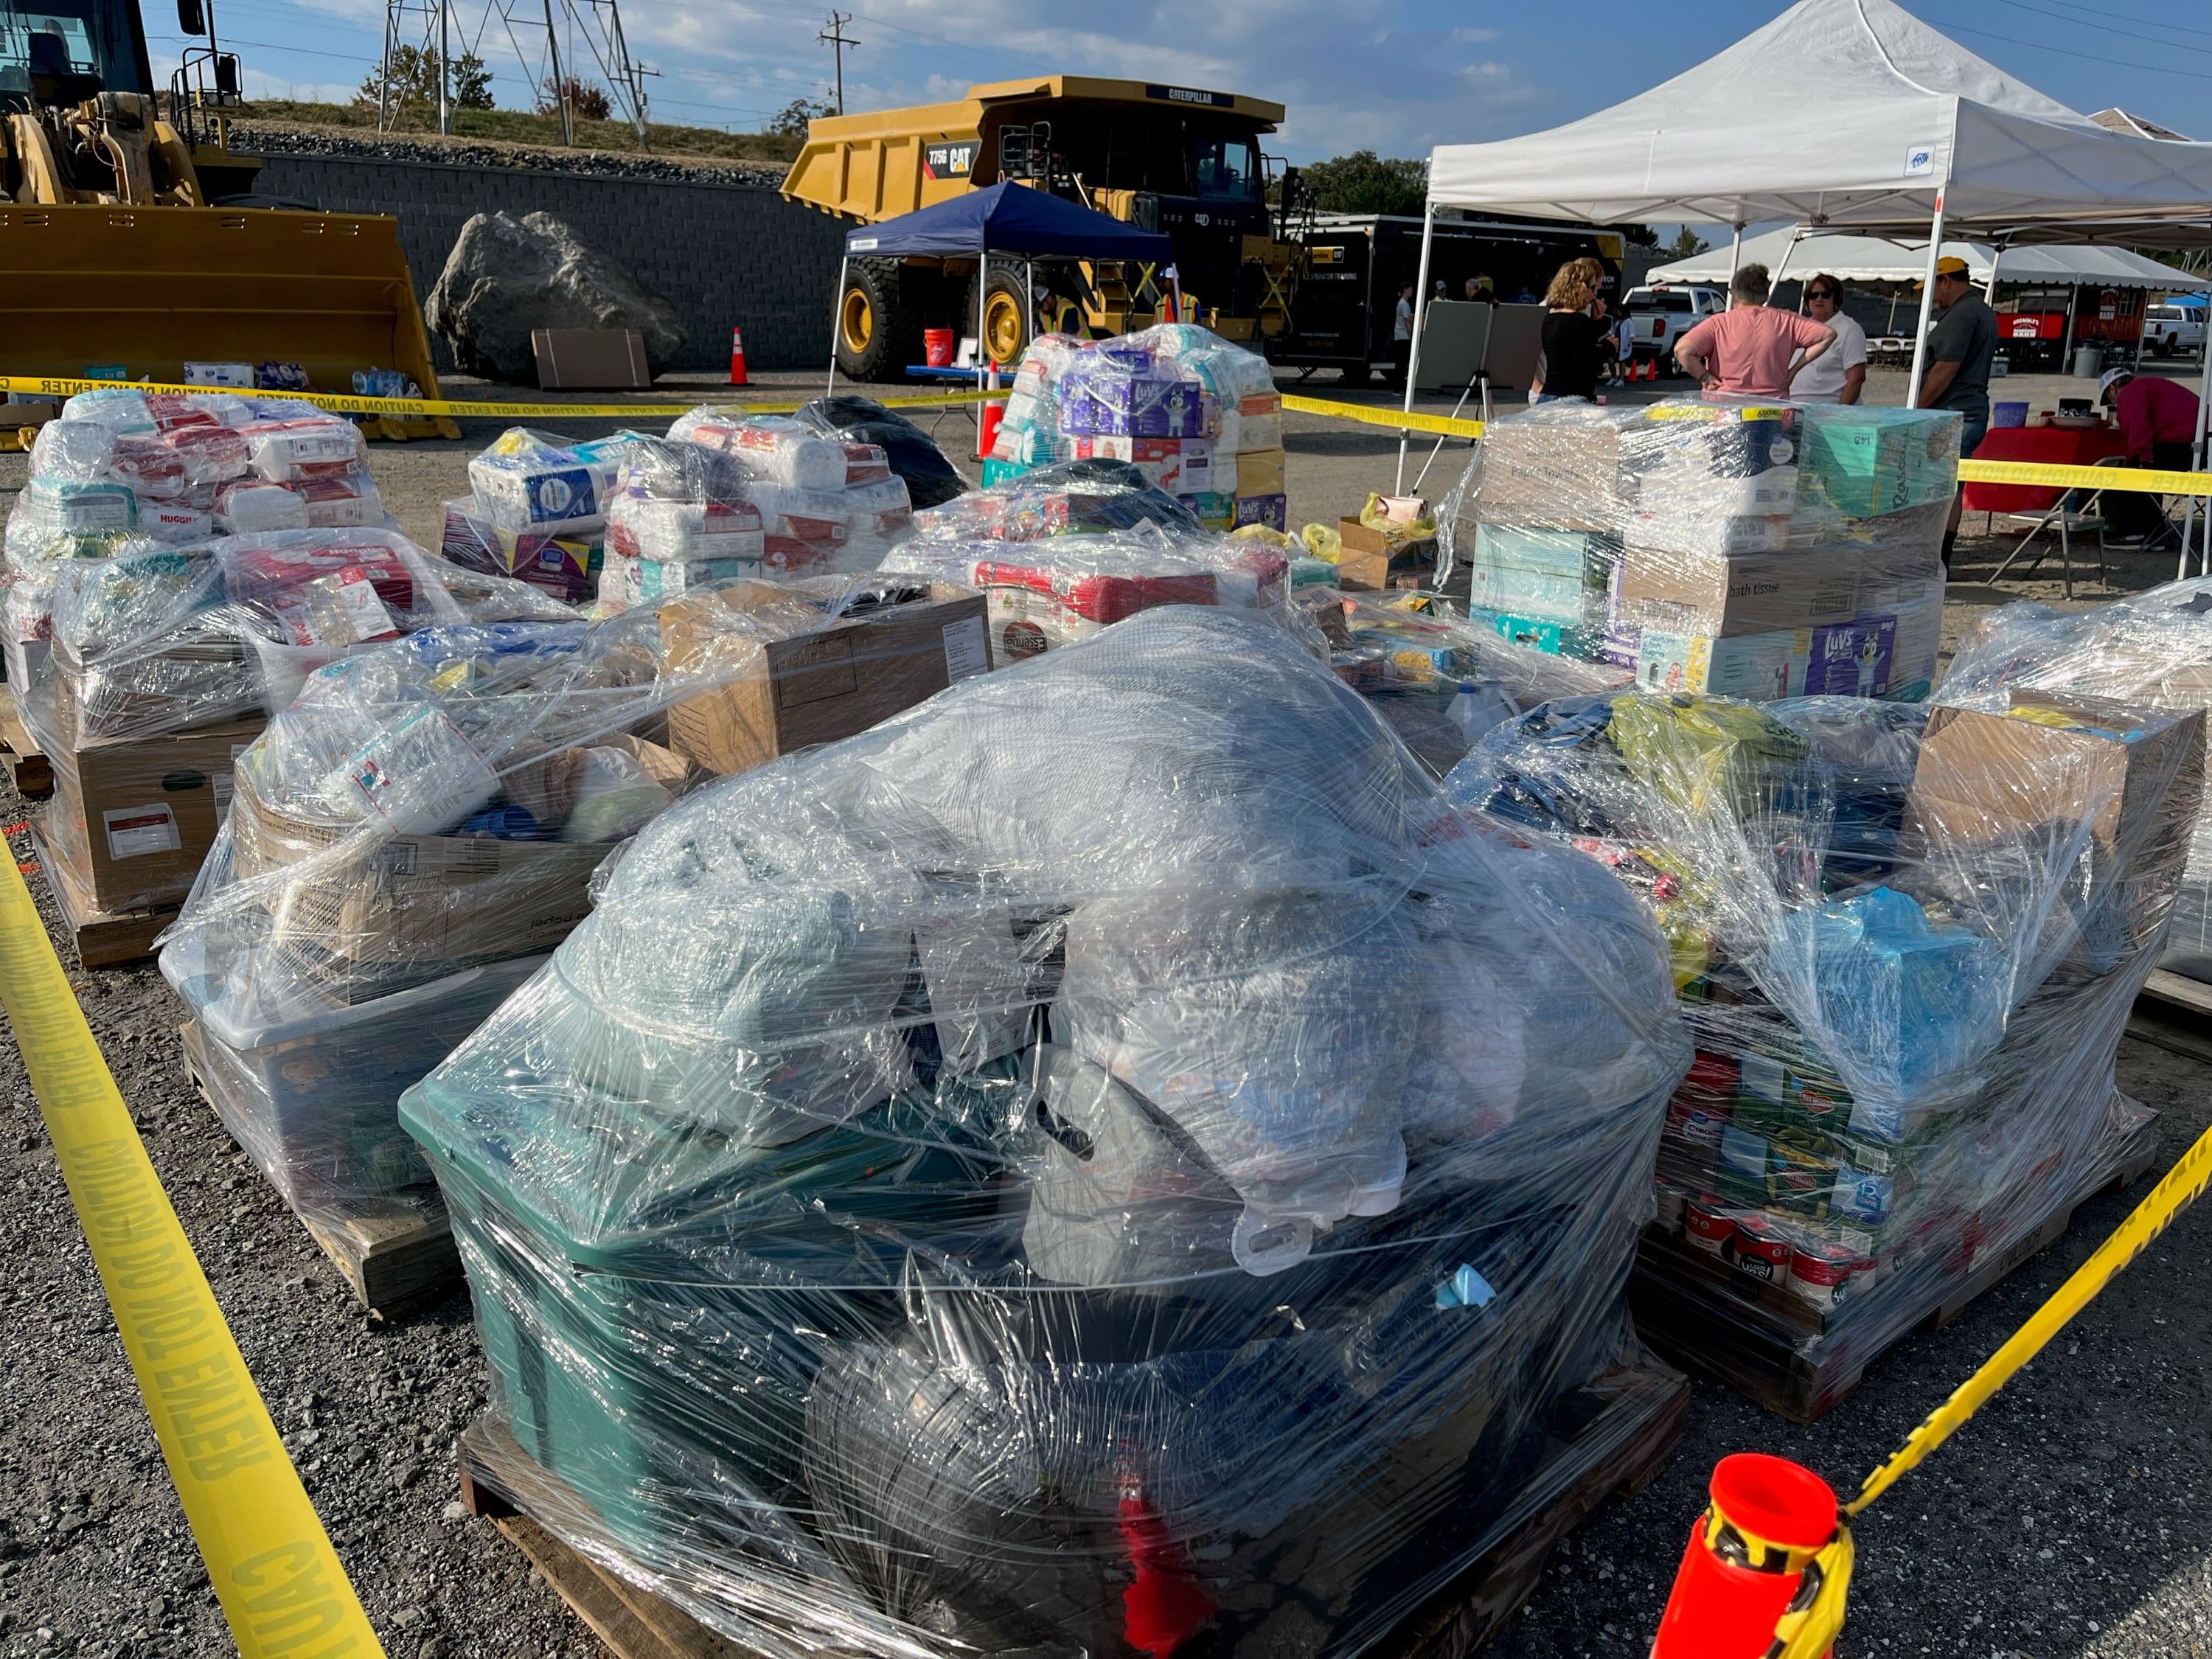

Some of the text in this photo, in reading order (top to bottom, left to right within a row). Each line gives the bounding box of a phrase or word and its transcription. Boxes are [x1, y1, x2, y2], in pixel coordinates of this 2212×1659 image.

[1169, 88, 1212, 104] CATERPILLAR
[929, 147, 971, 173] 775G CAT
[1512, 466, 1542, 481] Paper
[1728, 581, 1780, 597] bath tissue
[1644, 633, 1676, 646] Absorbent
[1648, 641, 1662, 650] Soft
[1433, 651, 1439, 661] 8
[1642, 647, 1665, 658] Diapers
[530, 913, 573, 929] papel
[1860, 1183, 1878, 1197] 12
